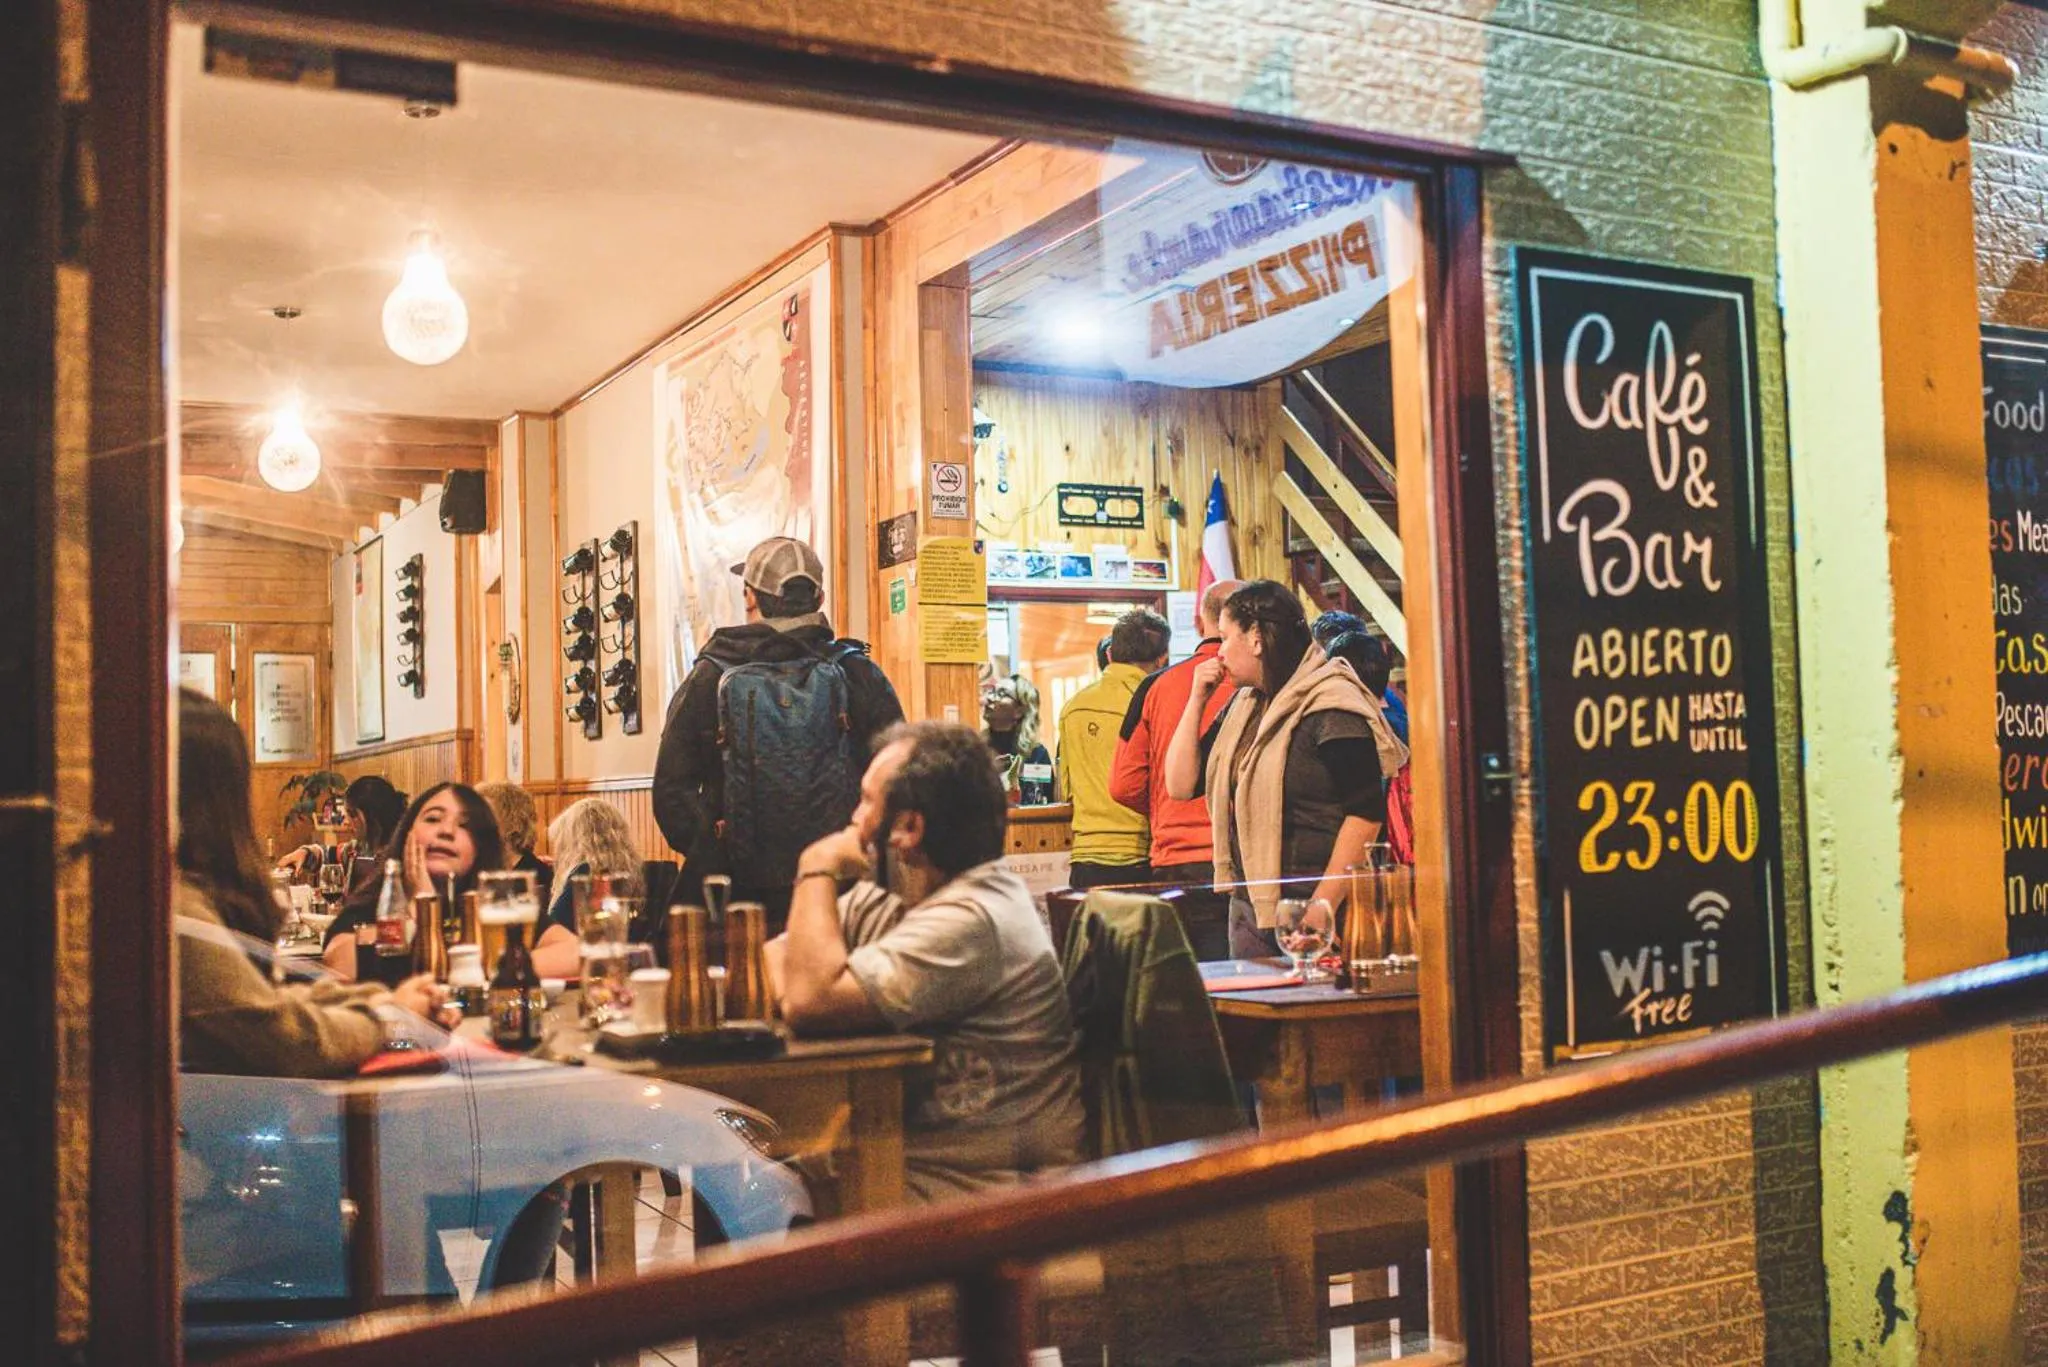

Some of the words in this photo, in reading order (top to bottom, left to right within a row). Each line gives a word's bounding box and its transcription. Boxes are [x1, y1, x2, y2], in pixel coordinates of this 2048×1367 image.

[1564, 312, 1709, 491] Café
[1684, 446, 1719, 509] &
[1557, 478, 1722, 598] Bar
[1571, 627, 1731, 679] ABIERTO
[1573, 695, 1680, 751] OPEN
[1688, 690, 1747, 721] HASTA
[1996, 691, 2048, 738] Pesca
[1689, 727, 1748, 753] UNTIL
[1577, 779, 1760, 874] 23:00
[1622, 987, 1692, 1034] Free
